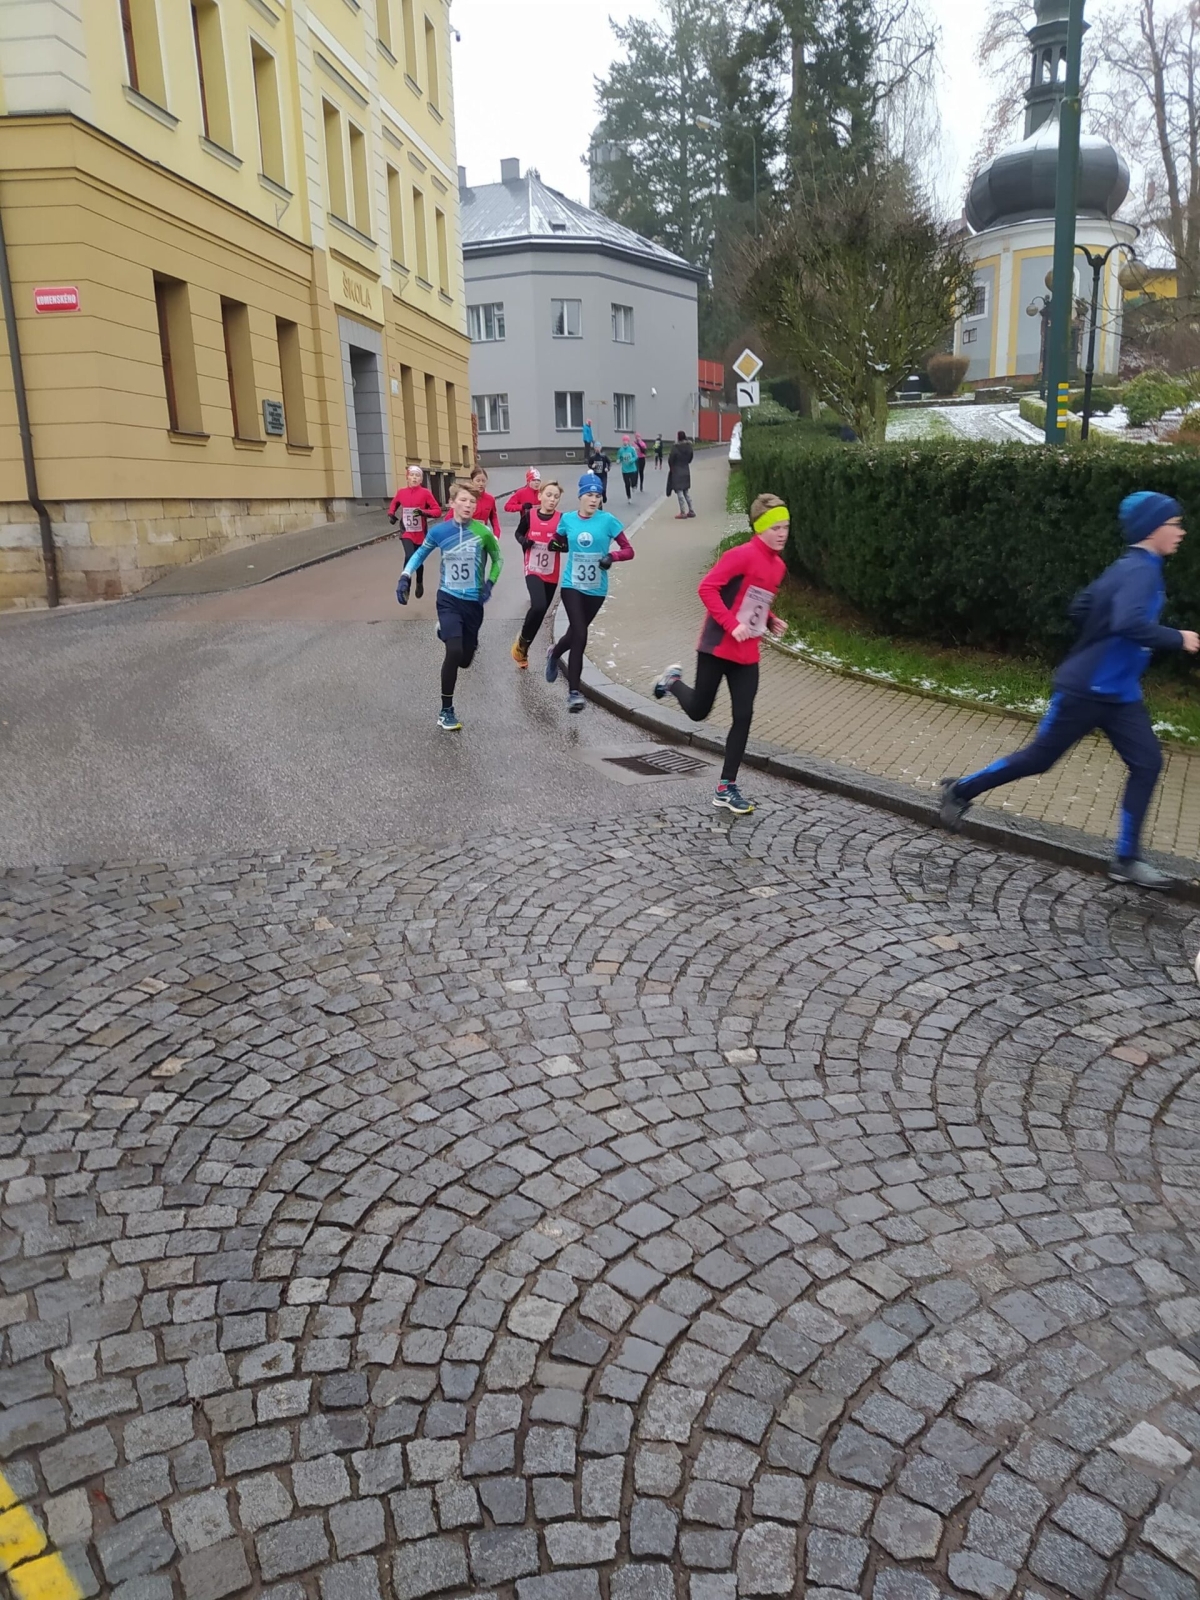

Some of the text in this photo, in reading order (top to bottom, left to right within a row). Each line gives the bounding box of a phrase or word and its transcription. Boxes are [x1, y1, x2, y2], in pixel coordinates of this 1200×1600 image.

[36, 293, 77, 305] KOMENSKÉHO
[342, 271, 372, 311] ŠKOLA
[406, 515, 419, 527] 55
[535, 552, 549, 567] 18
[451, 563, 470, 580] 35
[577, 564, 596, 581] 33
